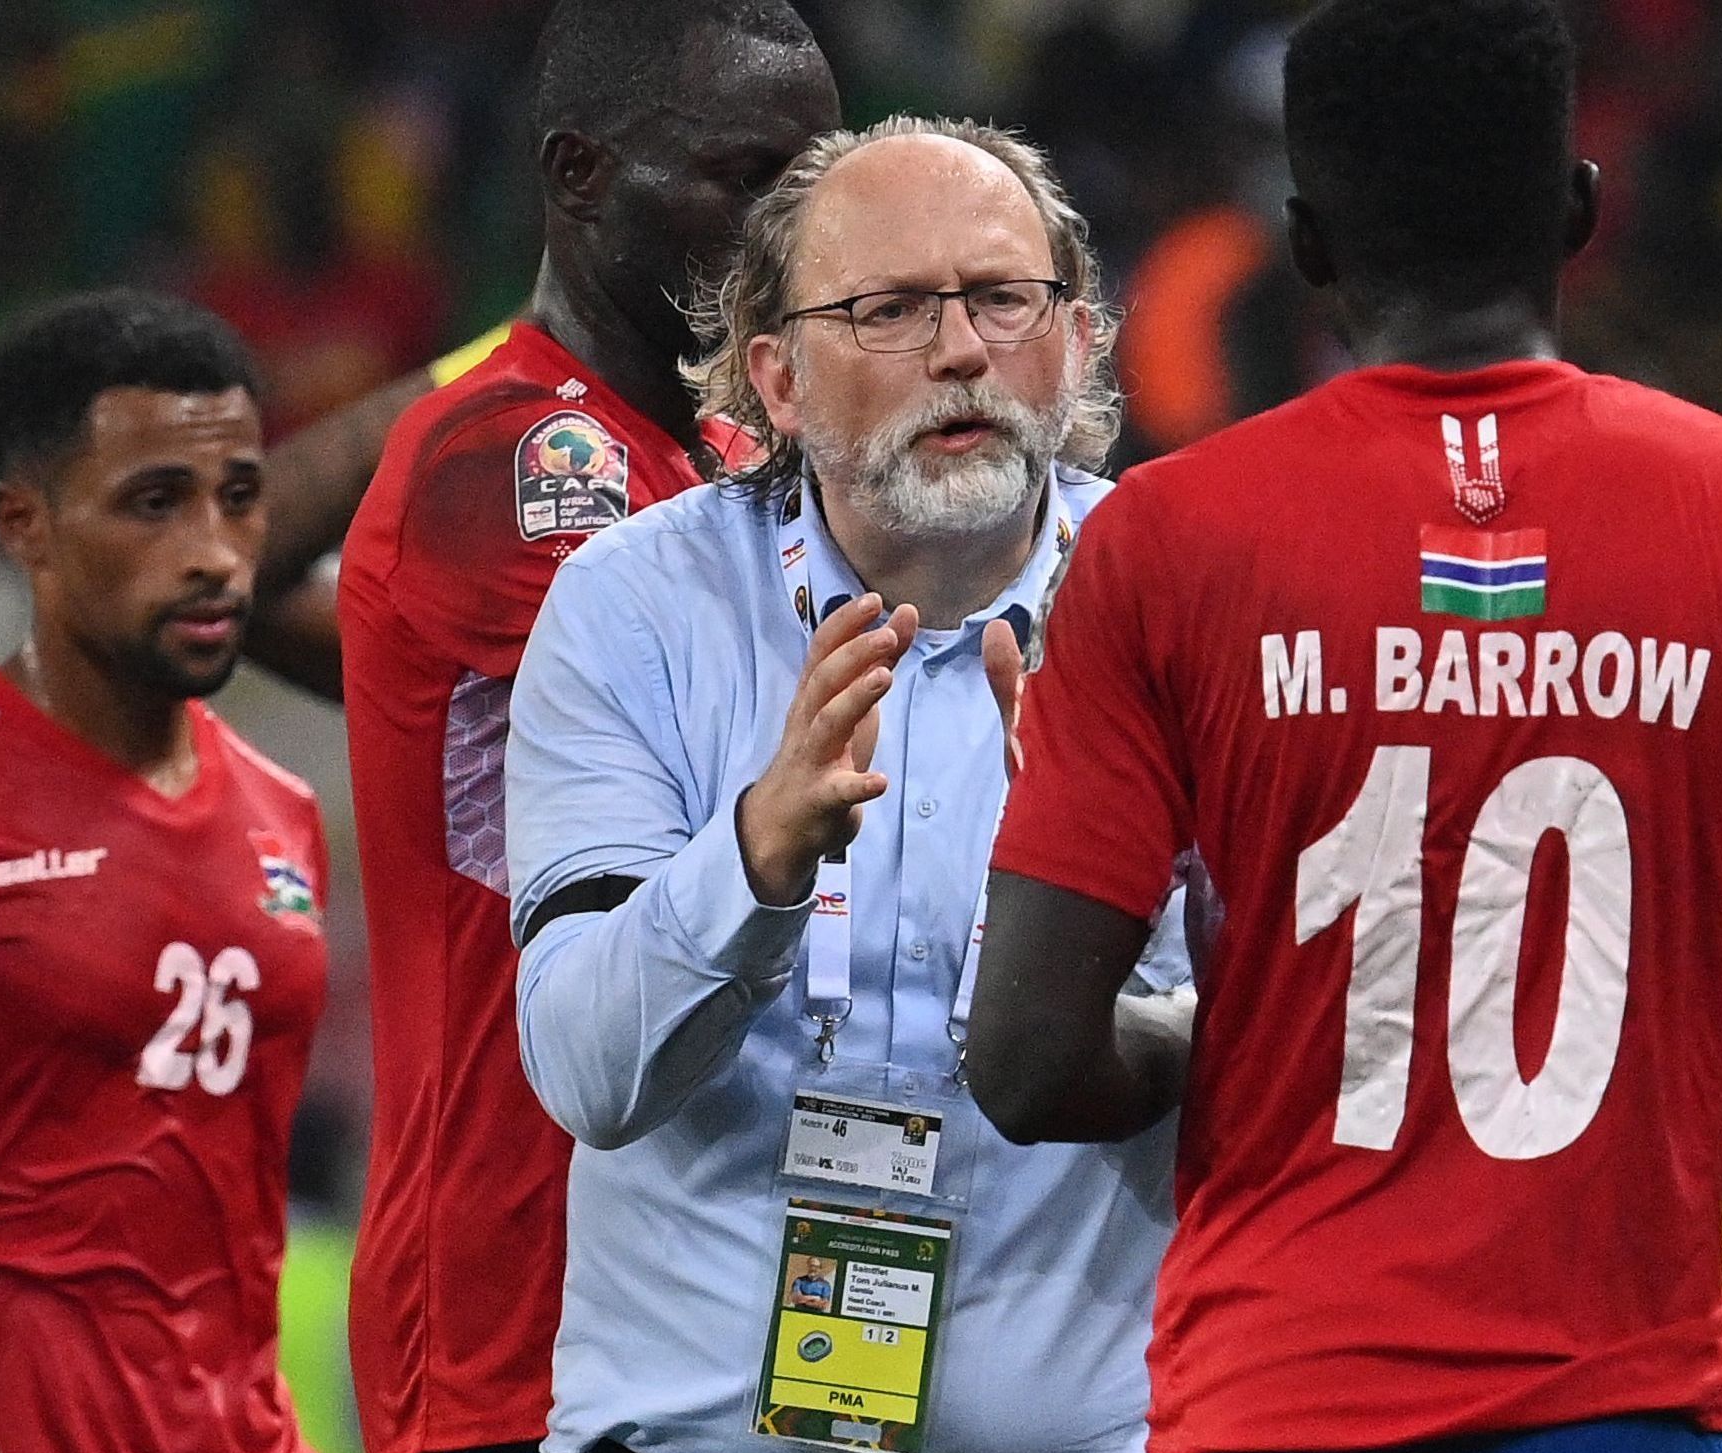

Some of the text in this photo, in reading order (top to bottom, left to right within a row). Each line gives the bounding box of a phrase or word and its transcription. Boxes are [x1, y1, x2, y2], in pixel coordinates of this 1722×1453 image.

[1260, 626, 1711, 730] M. BARROW
[1295, 744, 1632, 1160] 10
[136, 941, 261, 1096] 26
[832, 1119, 848, 1138] 46
[885, 1331, 895, 1343] 2
[829, 1391, 865, 1408] PMA
